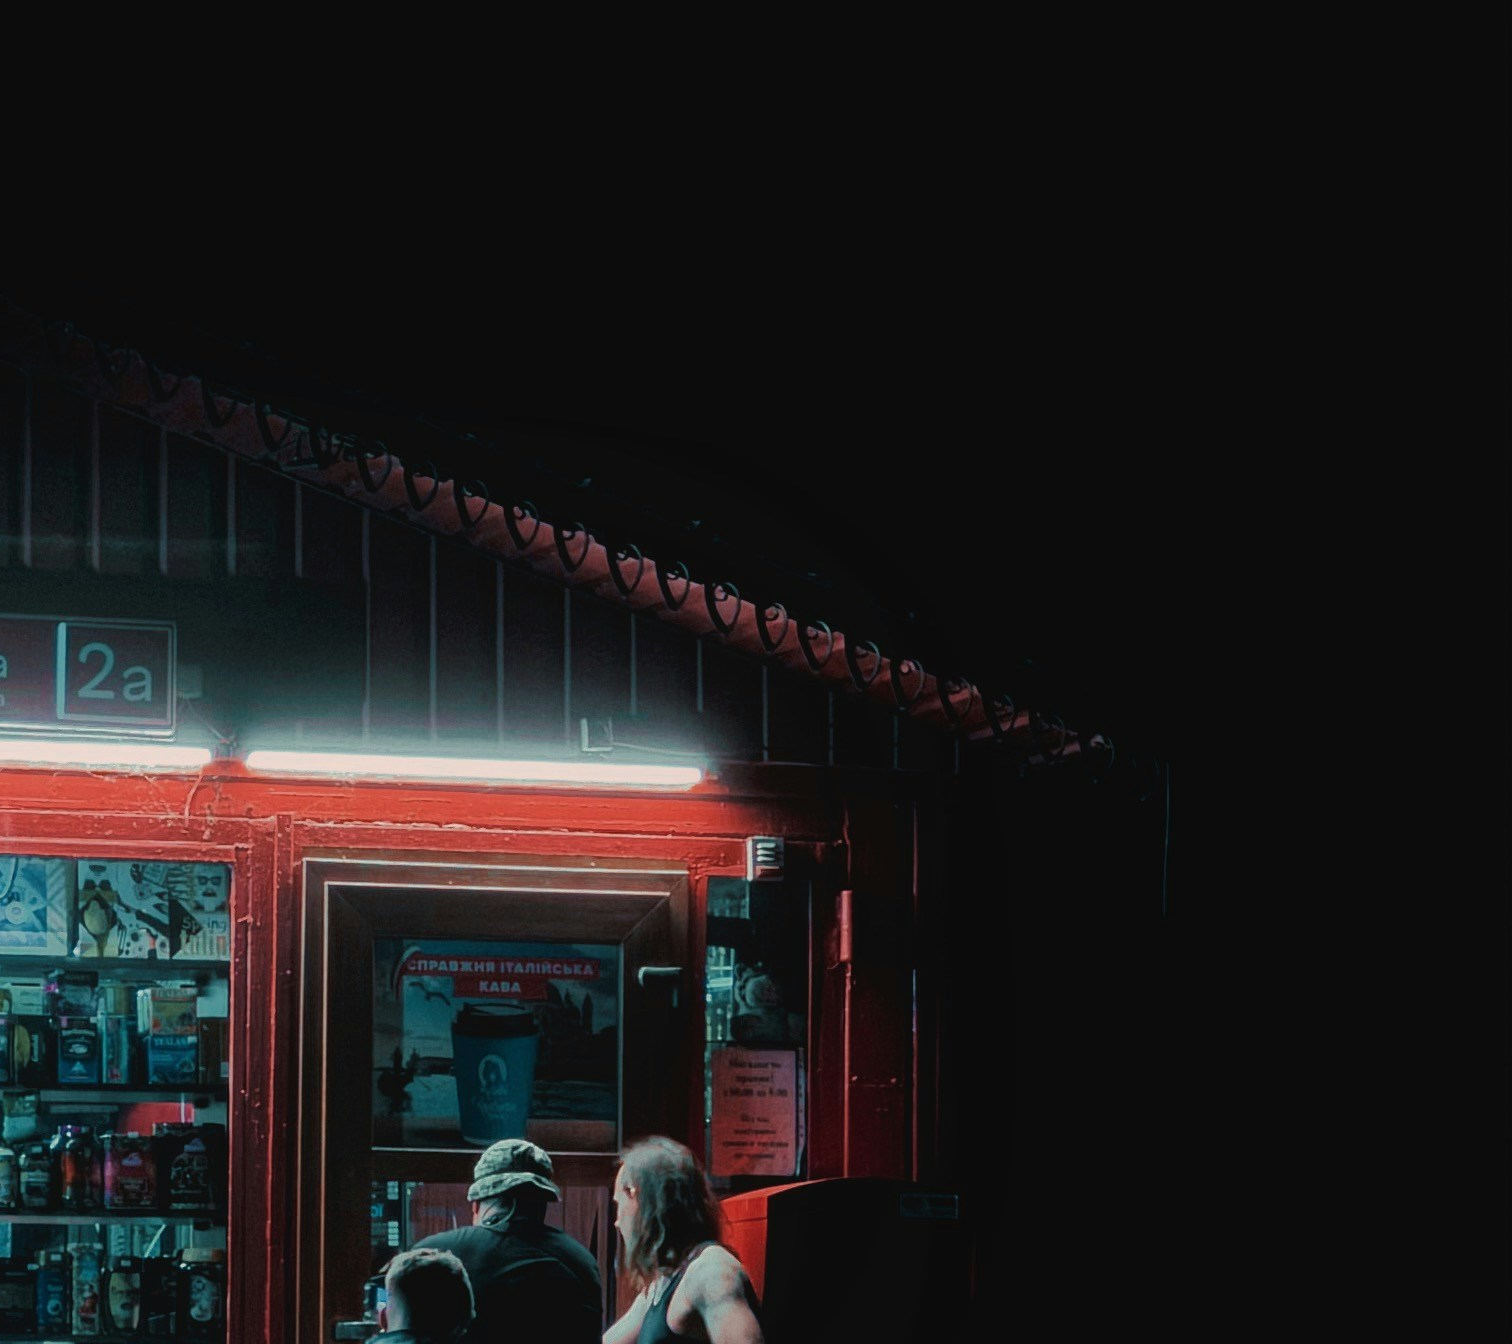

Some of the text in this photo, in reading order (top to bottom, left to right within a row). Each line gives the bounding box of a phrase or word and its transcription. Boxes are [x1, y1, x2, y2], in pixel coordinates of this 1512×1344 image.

[407, 959, 594, 976] СПРАВЖНЯ ІТАЛІЙСЬКА
[479, 979, 522, 993] КАВА
